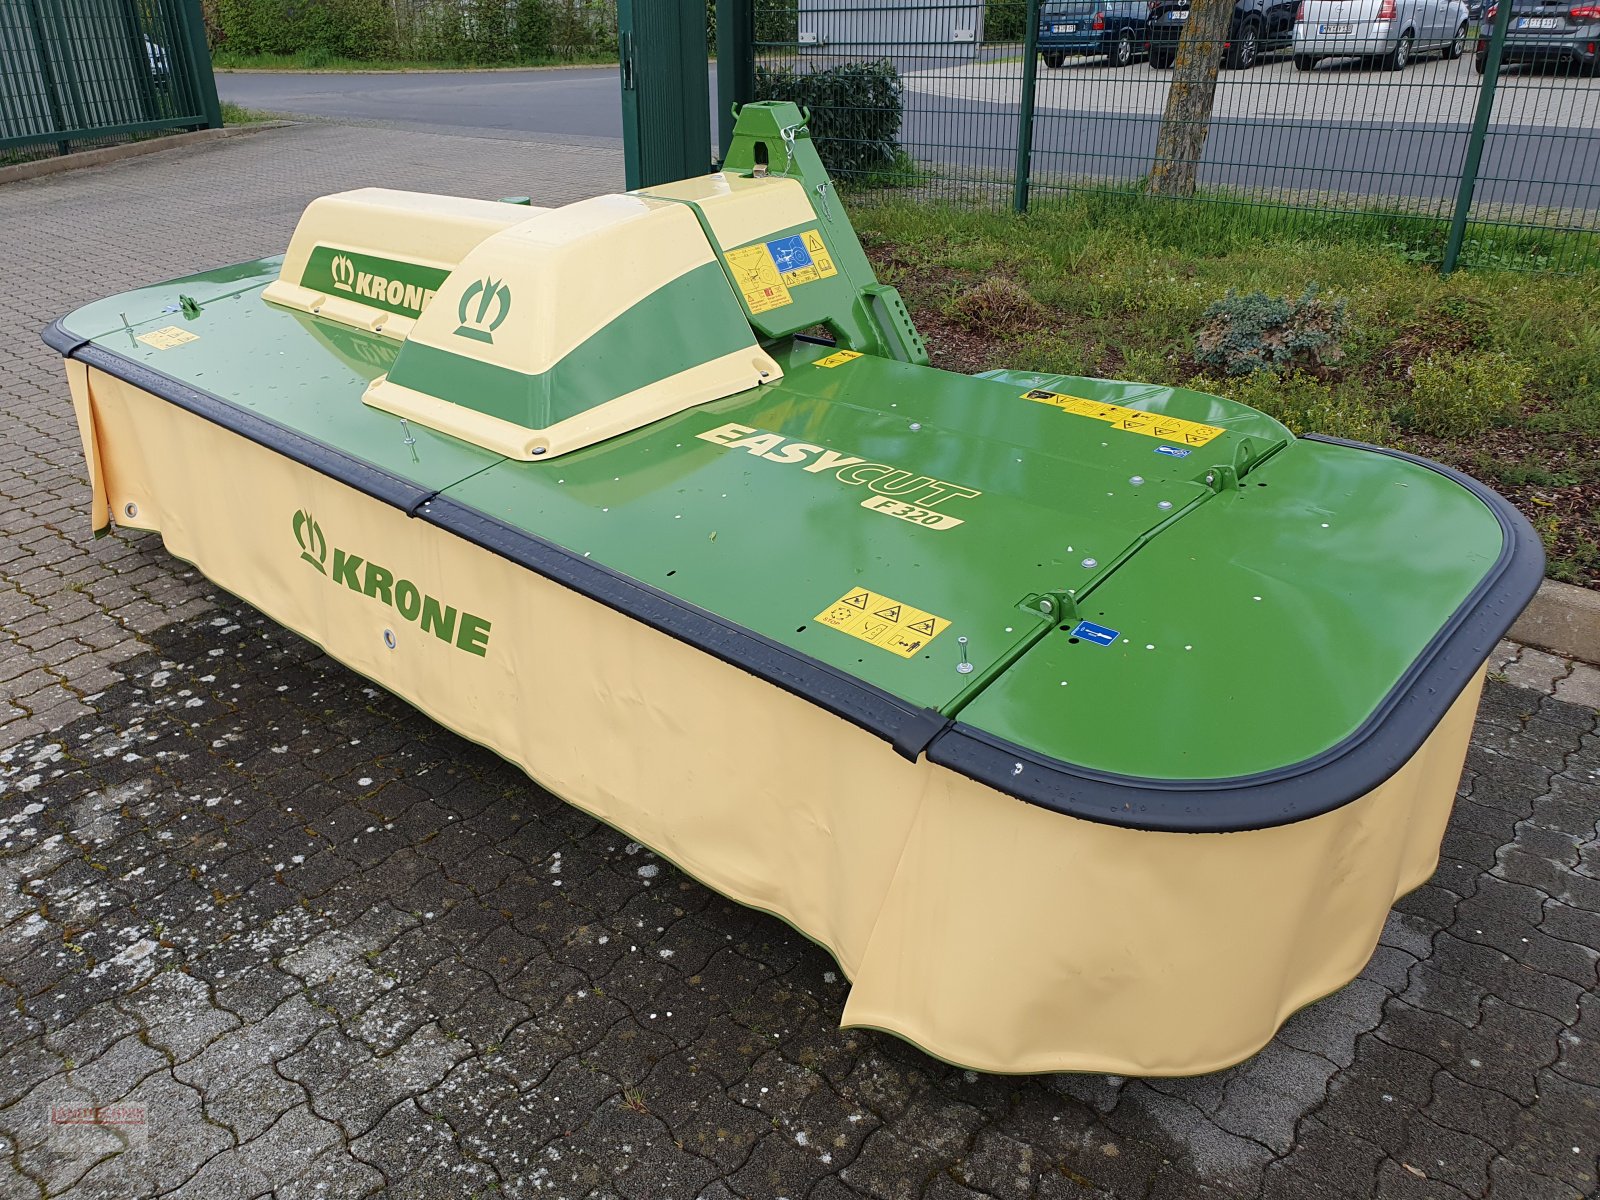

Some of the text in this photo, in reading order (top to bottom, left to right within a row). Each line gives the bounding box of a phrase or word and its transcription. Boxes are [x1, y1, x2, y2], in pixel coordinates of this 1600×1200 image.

[873, 500, 943, 525] F 320
[332, 547, 492, 658] KRONE
[822, 616, 841, 626] STOP
